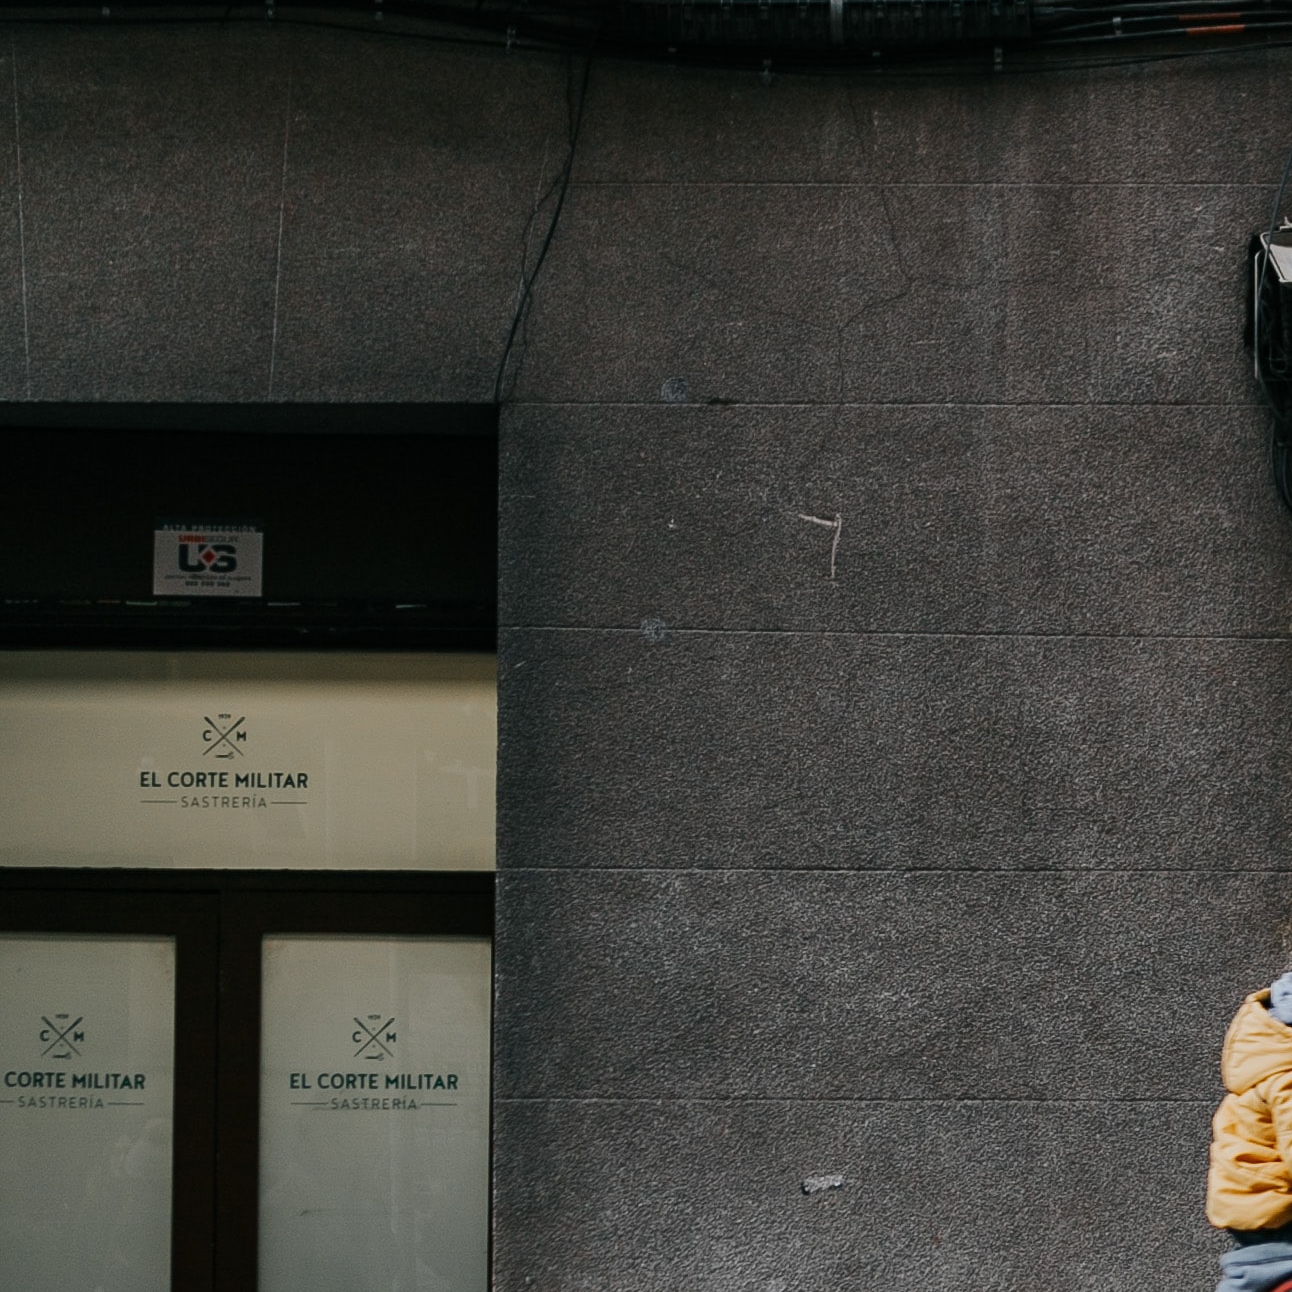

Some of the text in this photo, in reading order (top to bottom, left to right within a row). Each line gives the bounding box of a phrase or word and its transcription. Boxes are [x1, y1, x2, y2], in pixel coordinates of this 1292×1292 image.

[202, 729, 247, 742] C M
[140, 771, 308, 789] EL CORTE MILITAR
[180, 793, 267, 808] SASTRERÍA
[4, 1071, 146, 1090] CORTE MILITAR
[290, 1073, 459, 1090] EL CORTE MILITAR
[18, 1094, 104, 1109] SASTRERÍA
[330, 1095, 417, 1110] SASTRERÍA
